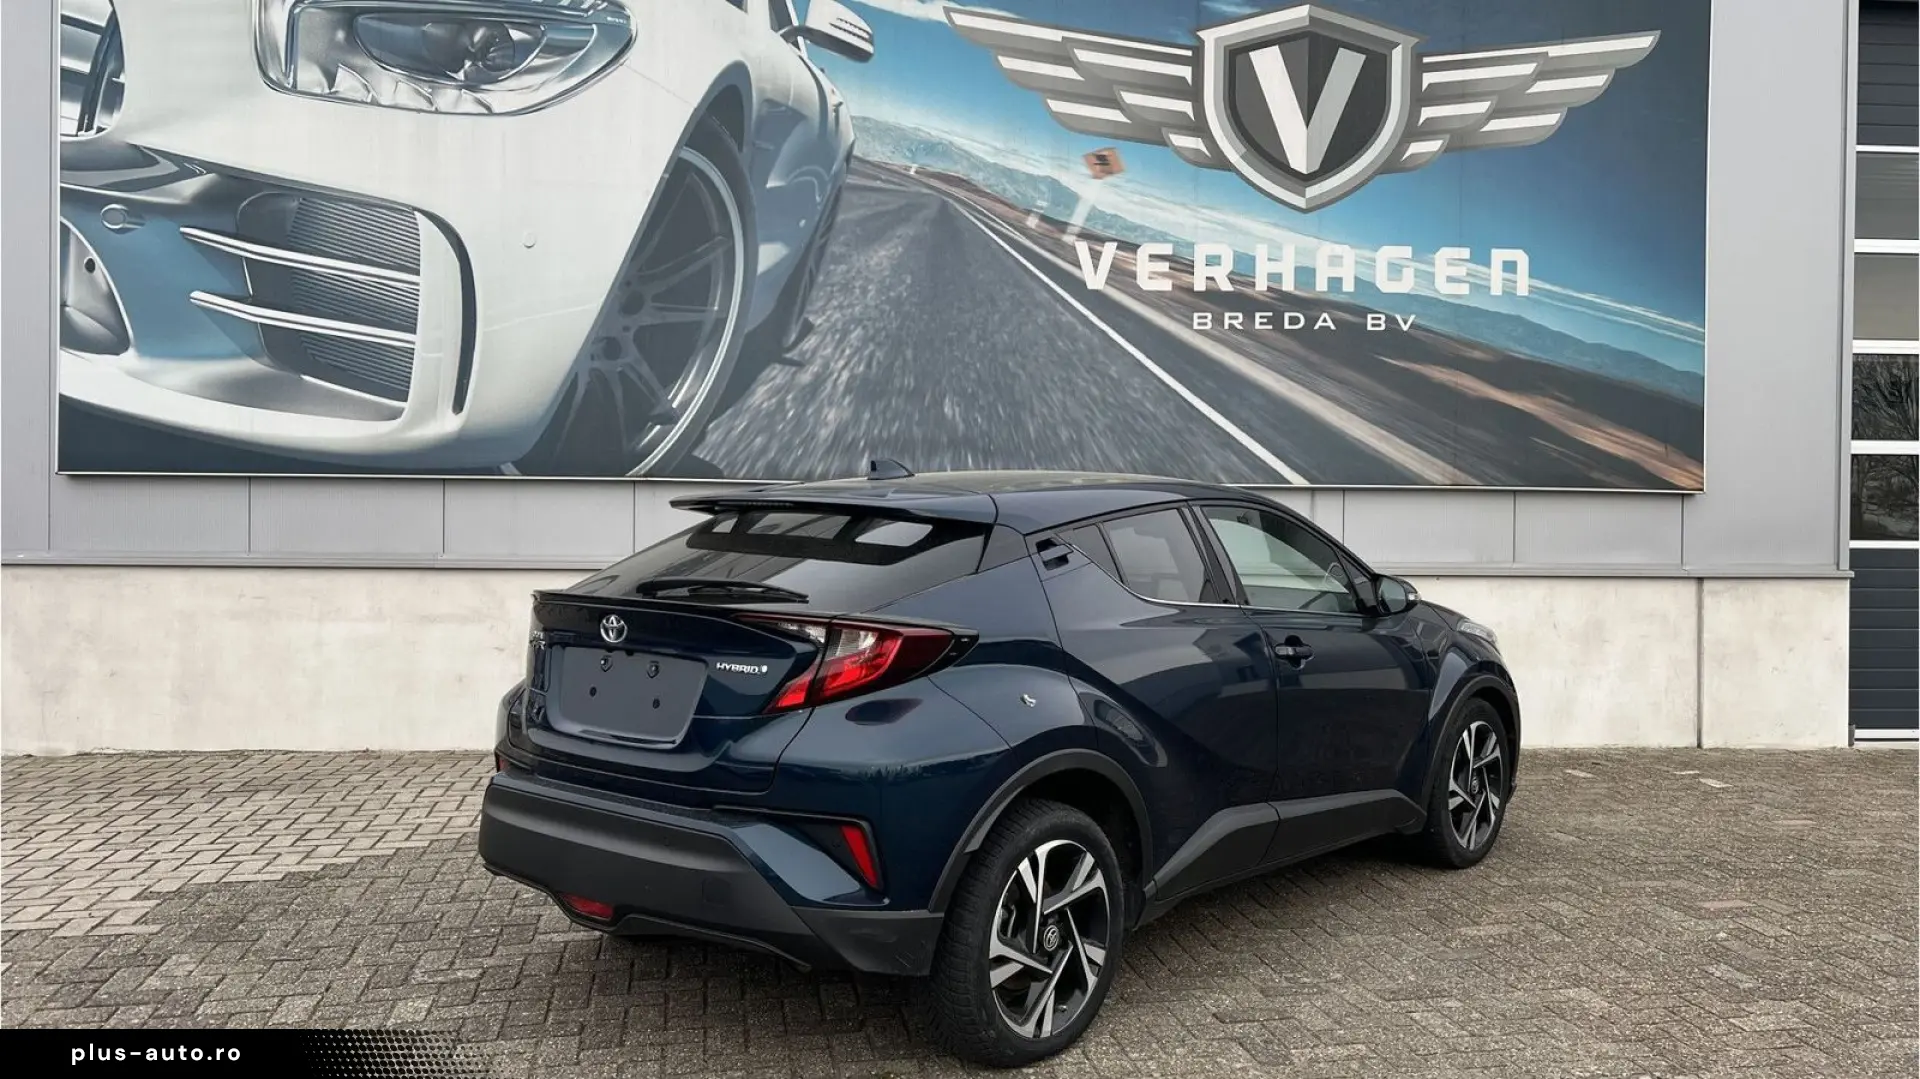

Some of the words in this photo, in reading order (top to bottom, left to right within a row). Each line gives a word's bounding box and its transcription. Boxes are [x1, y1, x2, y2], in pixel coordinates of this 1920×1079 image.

[1248, 45, 1366, 175] V
[1074, 240, 1530, 297] VERHAGEN
[1192, 311, 1337, 331] BREDA
[1366, 313, 1416, 332] BV
[716, 661, 759, 674] HYBRID
